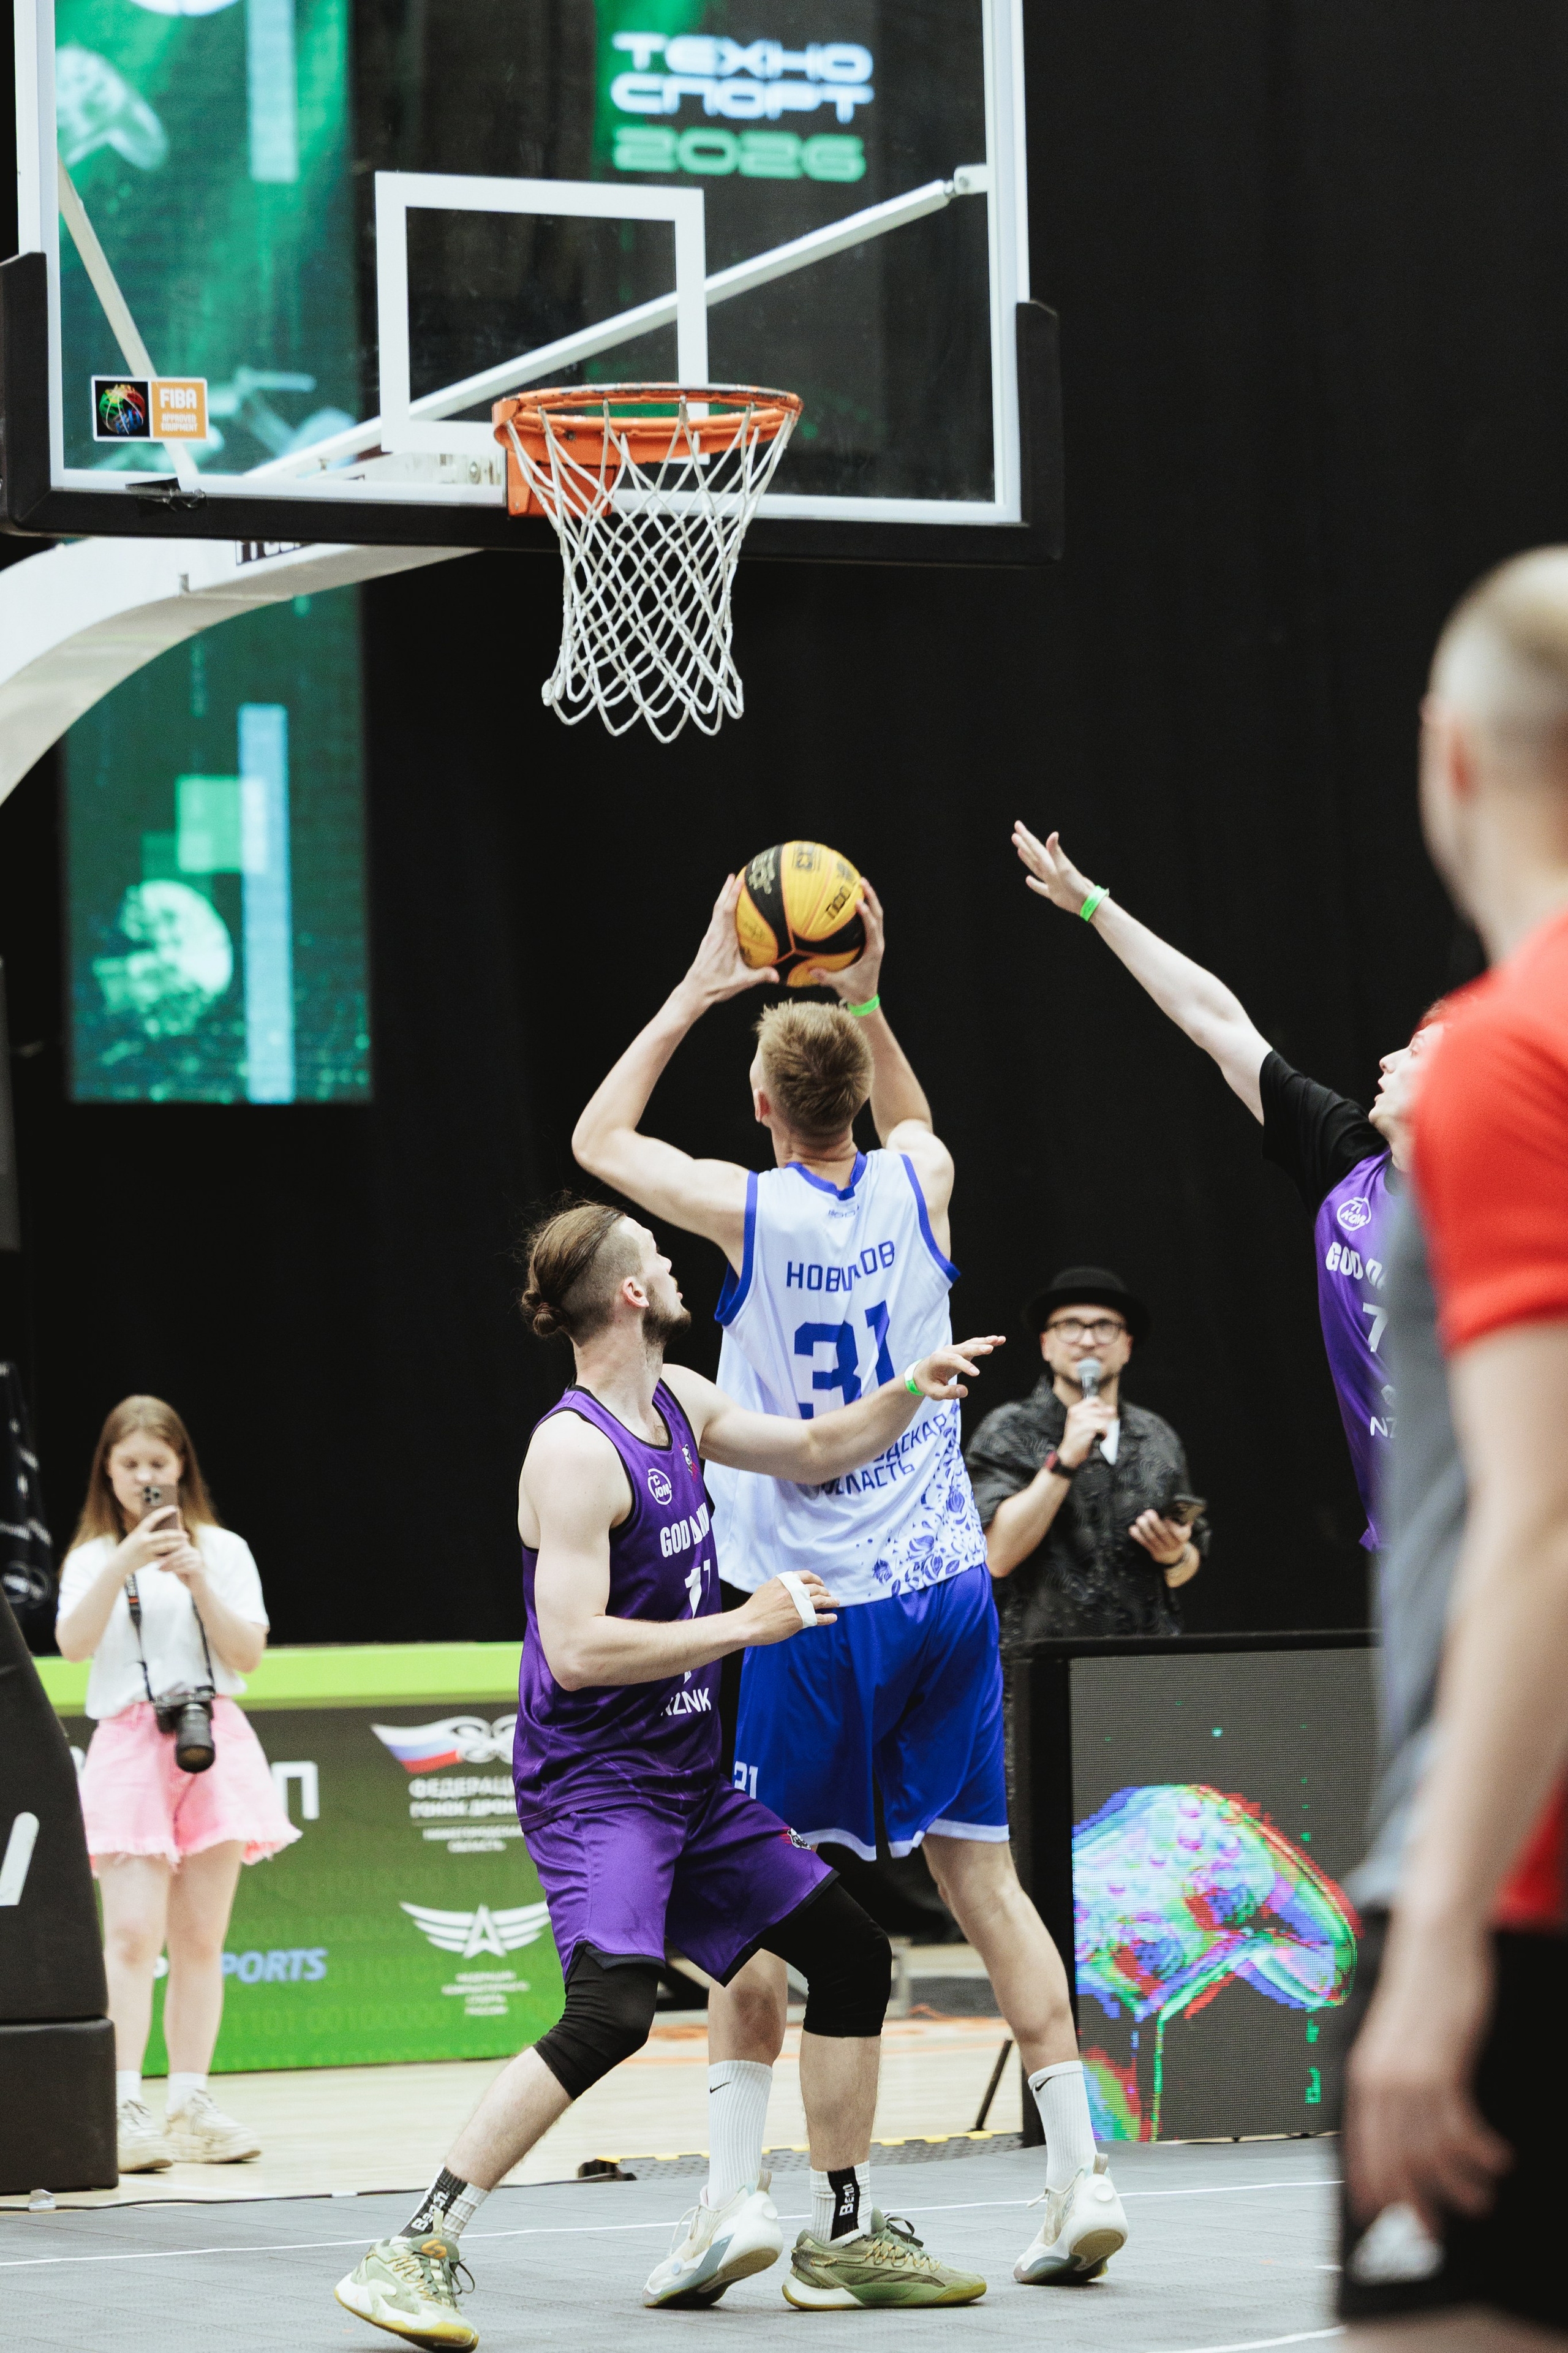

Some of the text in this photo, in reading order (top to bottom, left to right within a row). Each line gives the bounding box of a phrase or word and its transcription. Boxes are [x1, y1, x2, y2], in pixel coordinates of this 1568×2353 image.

[613, 125, 867, 183] 2026
[160, 388, 197, 409] FIBA
[1325, 1242, 1363, 1280] GOD
[794, 1300, 895, 1420] 31
[660, 1519, 691, 1558] GOD
